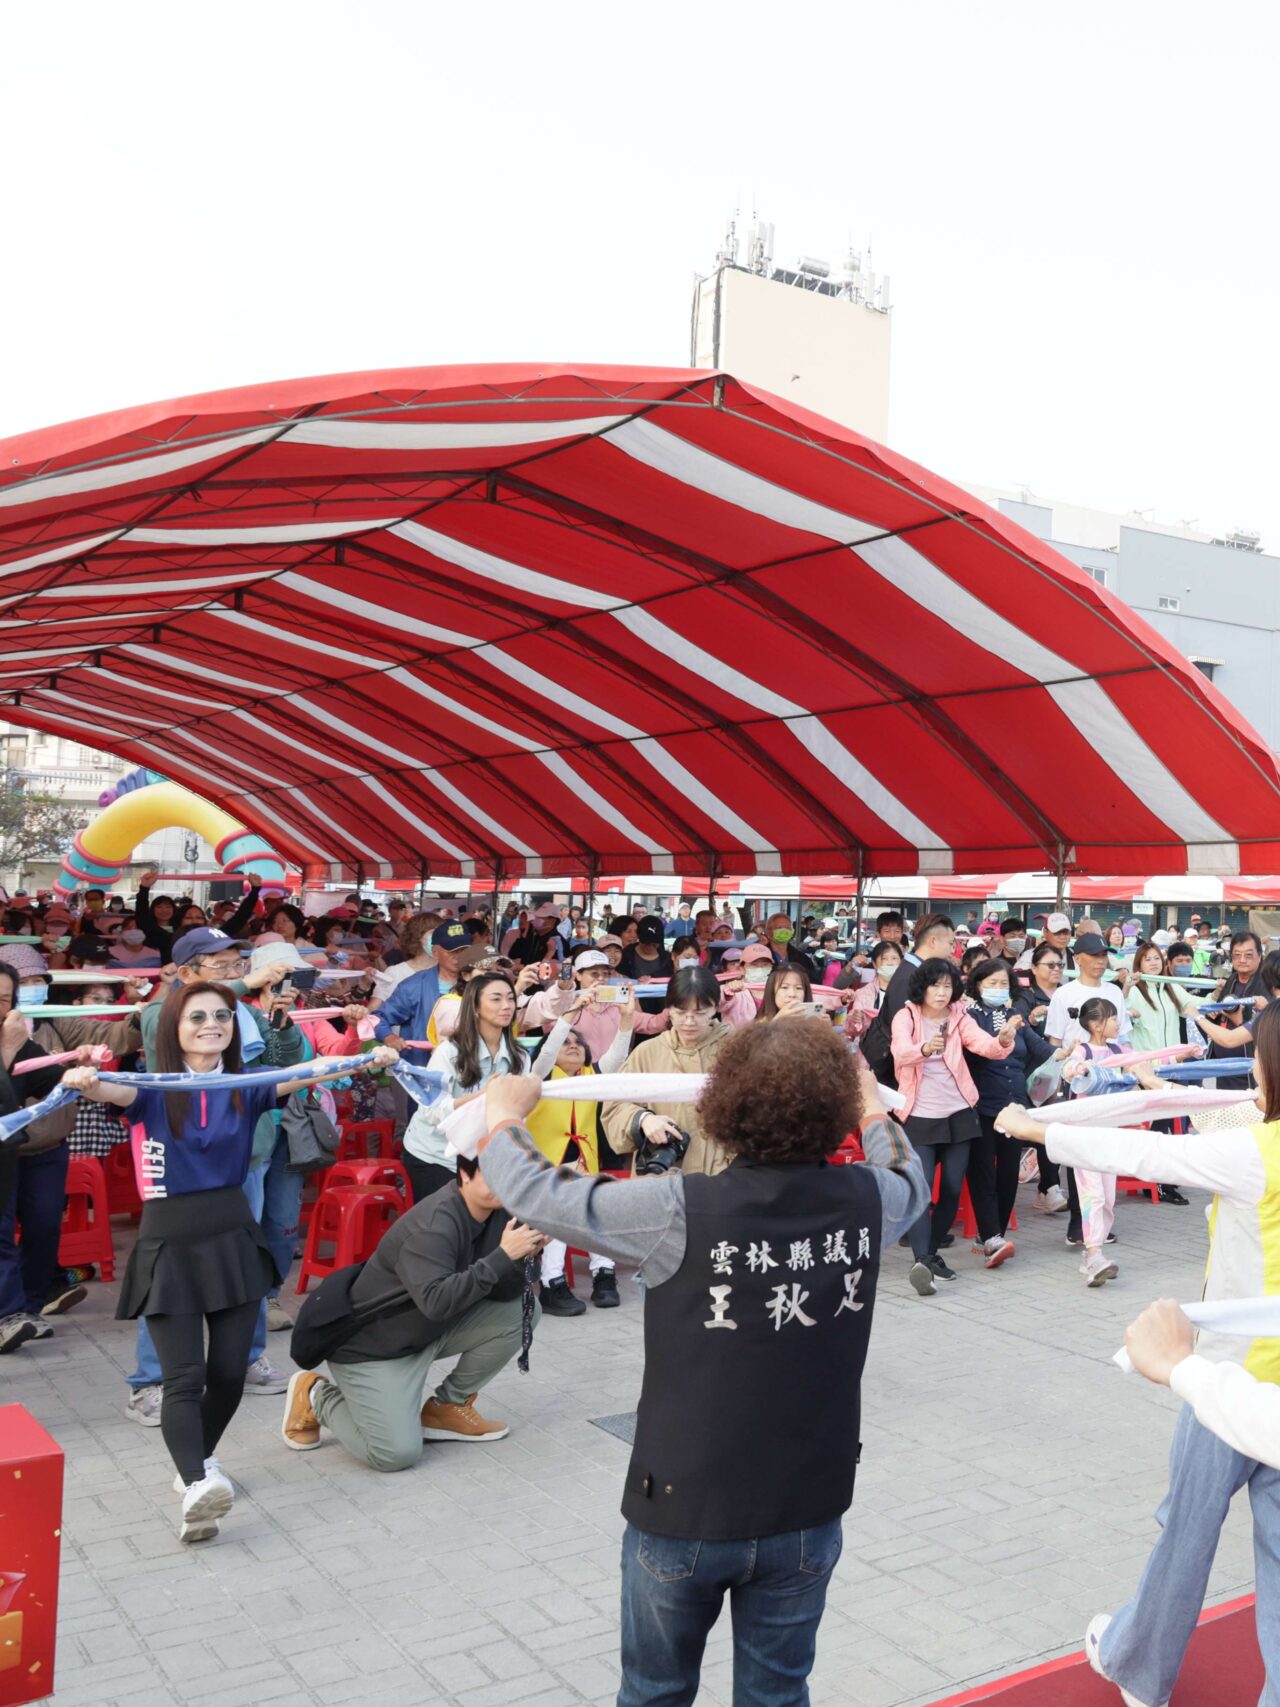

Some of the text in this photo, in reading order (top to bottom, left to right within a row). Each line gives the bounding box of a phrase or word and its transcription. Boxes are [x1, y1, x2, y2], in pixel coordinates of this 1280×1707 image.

[710, 1227, 871, 1276] 雲林縣議員
[704, 1268, 865, 1331] 王秋足
